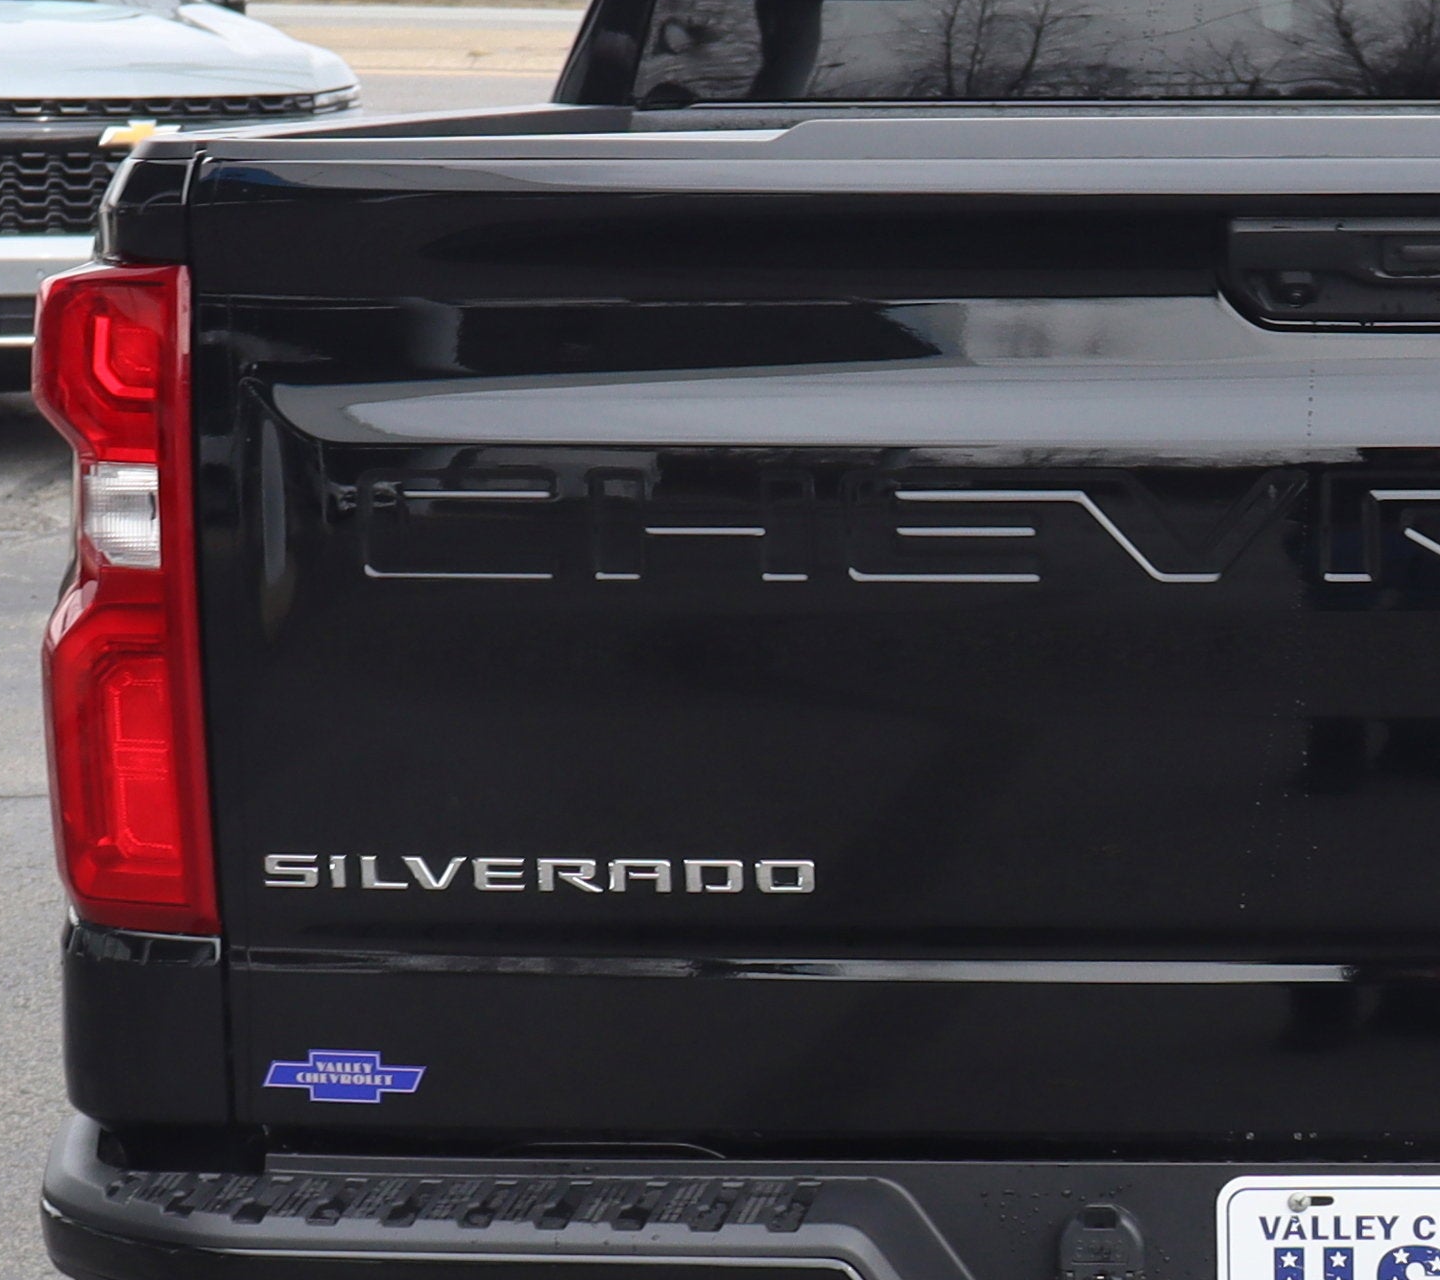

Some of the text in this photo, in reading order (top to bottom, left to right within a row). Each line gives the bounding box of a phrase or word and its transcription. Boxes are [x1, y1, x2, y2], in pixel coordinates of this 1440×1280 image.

[264, 853, 816, 894] SILVERADO
[315, 1061, 375, 1074] VALLEY
[295, 1071, 393, 1086] CHEVROLET
[1258, 1215, 1399, 1241] VALLEY
